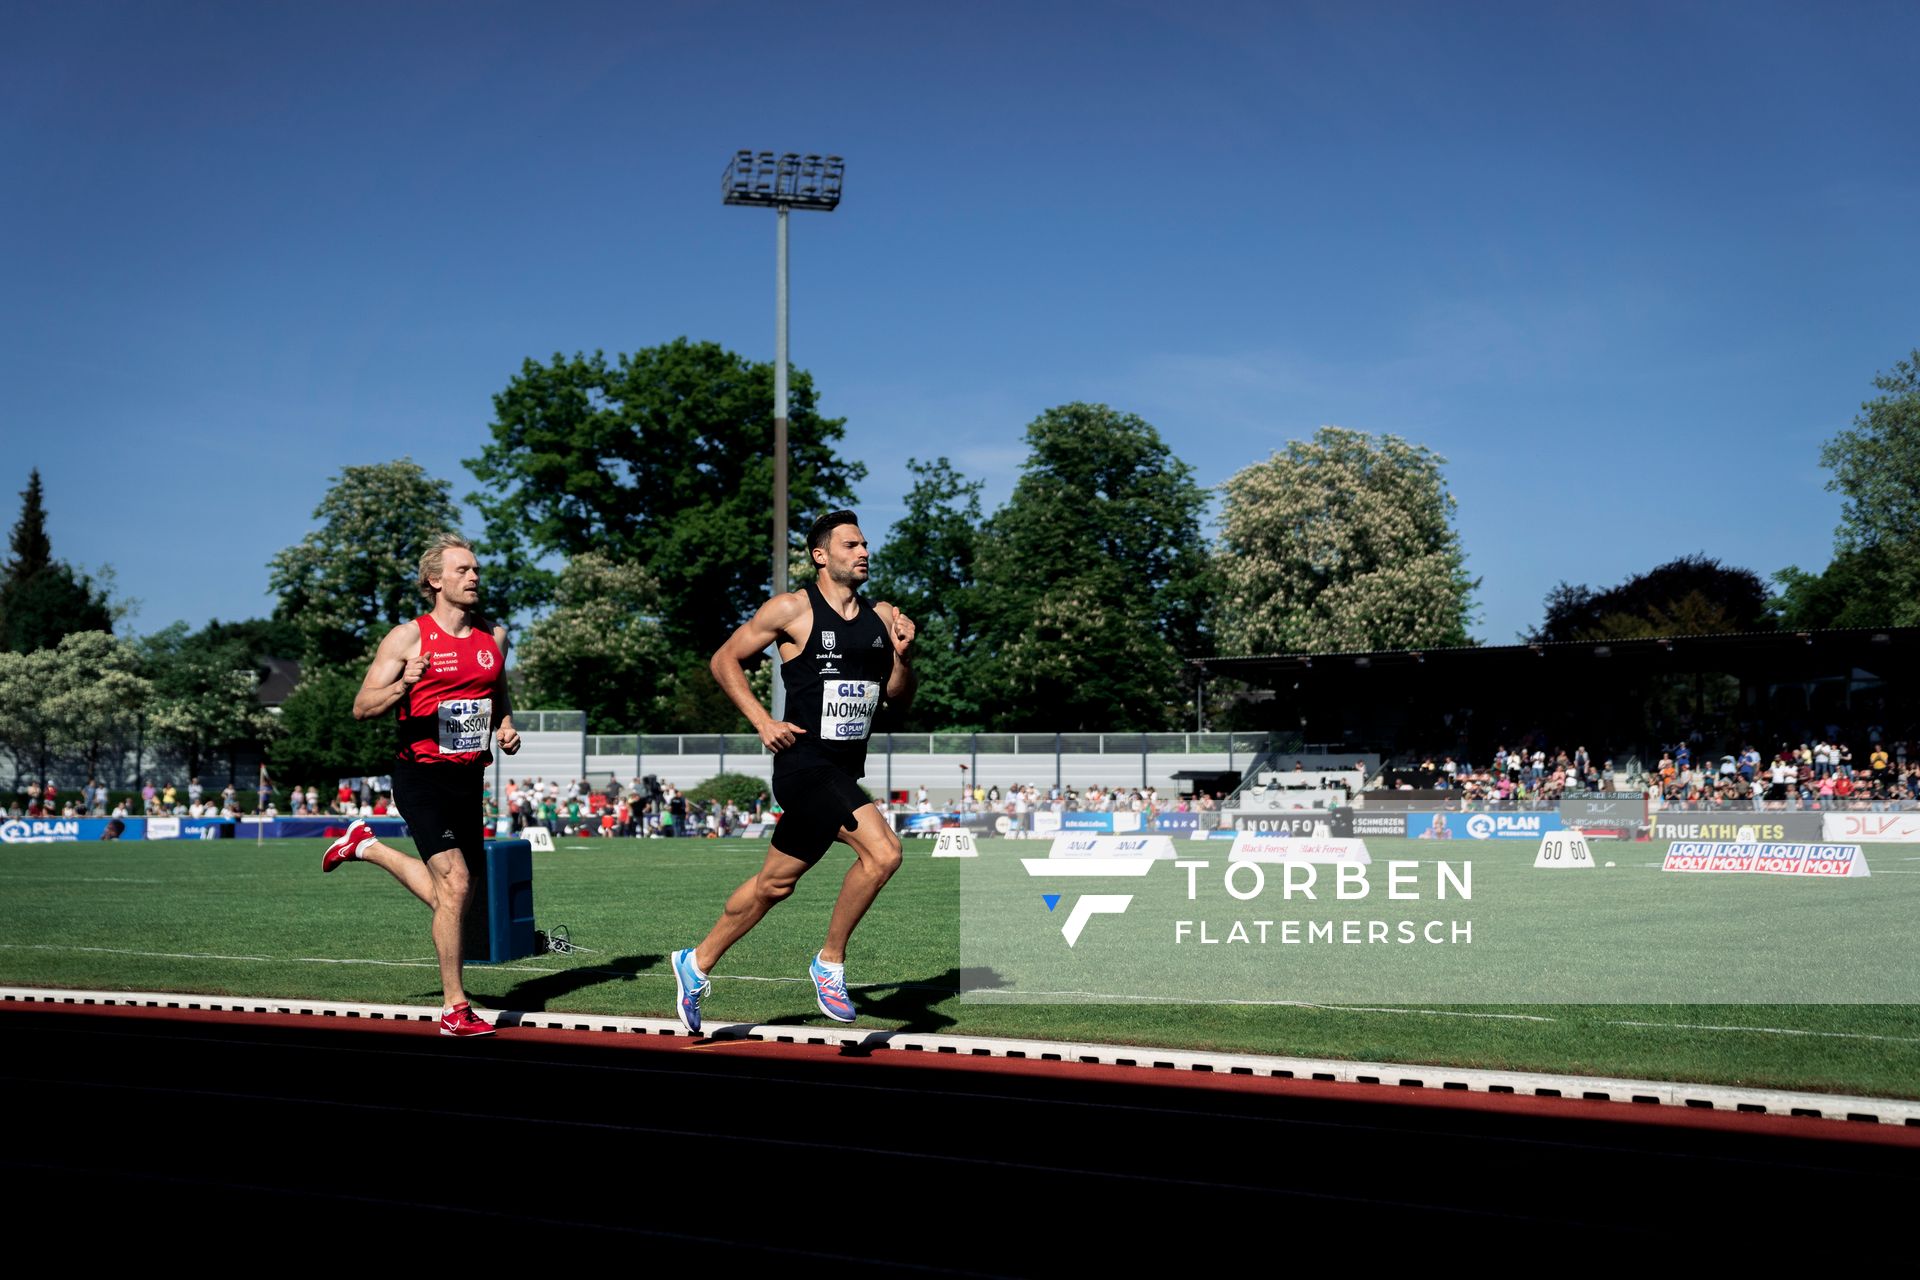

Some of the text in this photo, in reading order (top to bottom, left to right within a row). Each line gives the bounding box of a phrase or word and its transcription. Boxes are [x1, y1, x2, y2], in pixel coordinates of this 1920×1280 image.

[838, 683, 865, 697] GLS
[451, 702, 479, 714] GLS
[827, 702, 876, 717] NOWAK
[446, 718, 488, 733] NILSSON
[33, 822, 79, 834] PLAN
[1358, 818, 1405, 826] SCHMERZEN
[1498, 816, 1540, 830] PLAN
[1353, 826, 1405, 834] SPANNUNGEN
[1656, 824, 1784, 839] TRUEATHLTES
[534, 833, 547, 846] 40
[939, 836, 950, 850] 50
[956, 836, 969, 850] 50
[1544, 841, 1586, 860] 60 60
[1672, 844, 1711, 857] LIQUI
[1715, 844, 1755, 857] LIQUI
[1761, 845, 1802, 859] LIQUI
[1809, 847, 1852, 861] LIQUI
[1667, 857, 1707, 870] MOLY
[1711, 858, 1751, 871] MOLY
[1757, 858, 1800, 872] MOLY
[1804, 861, 1849, 874] MOLY
